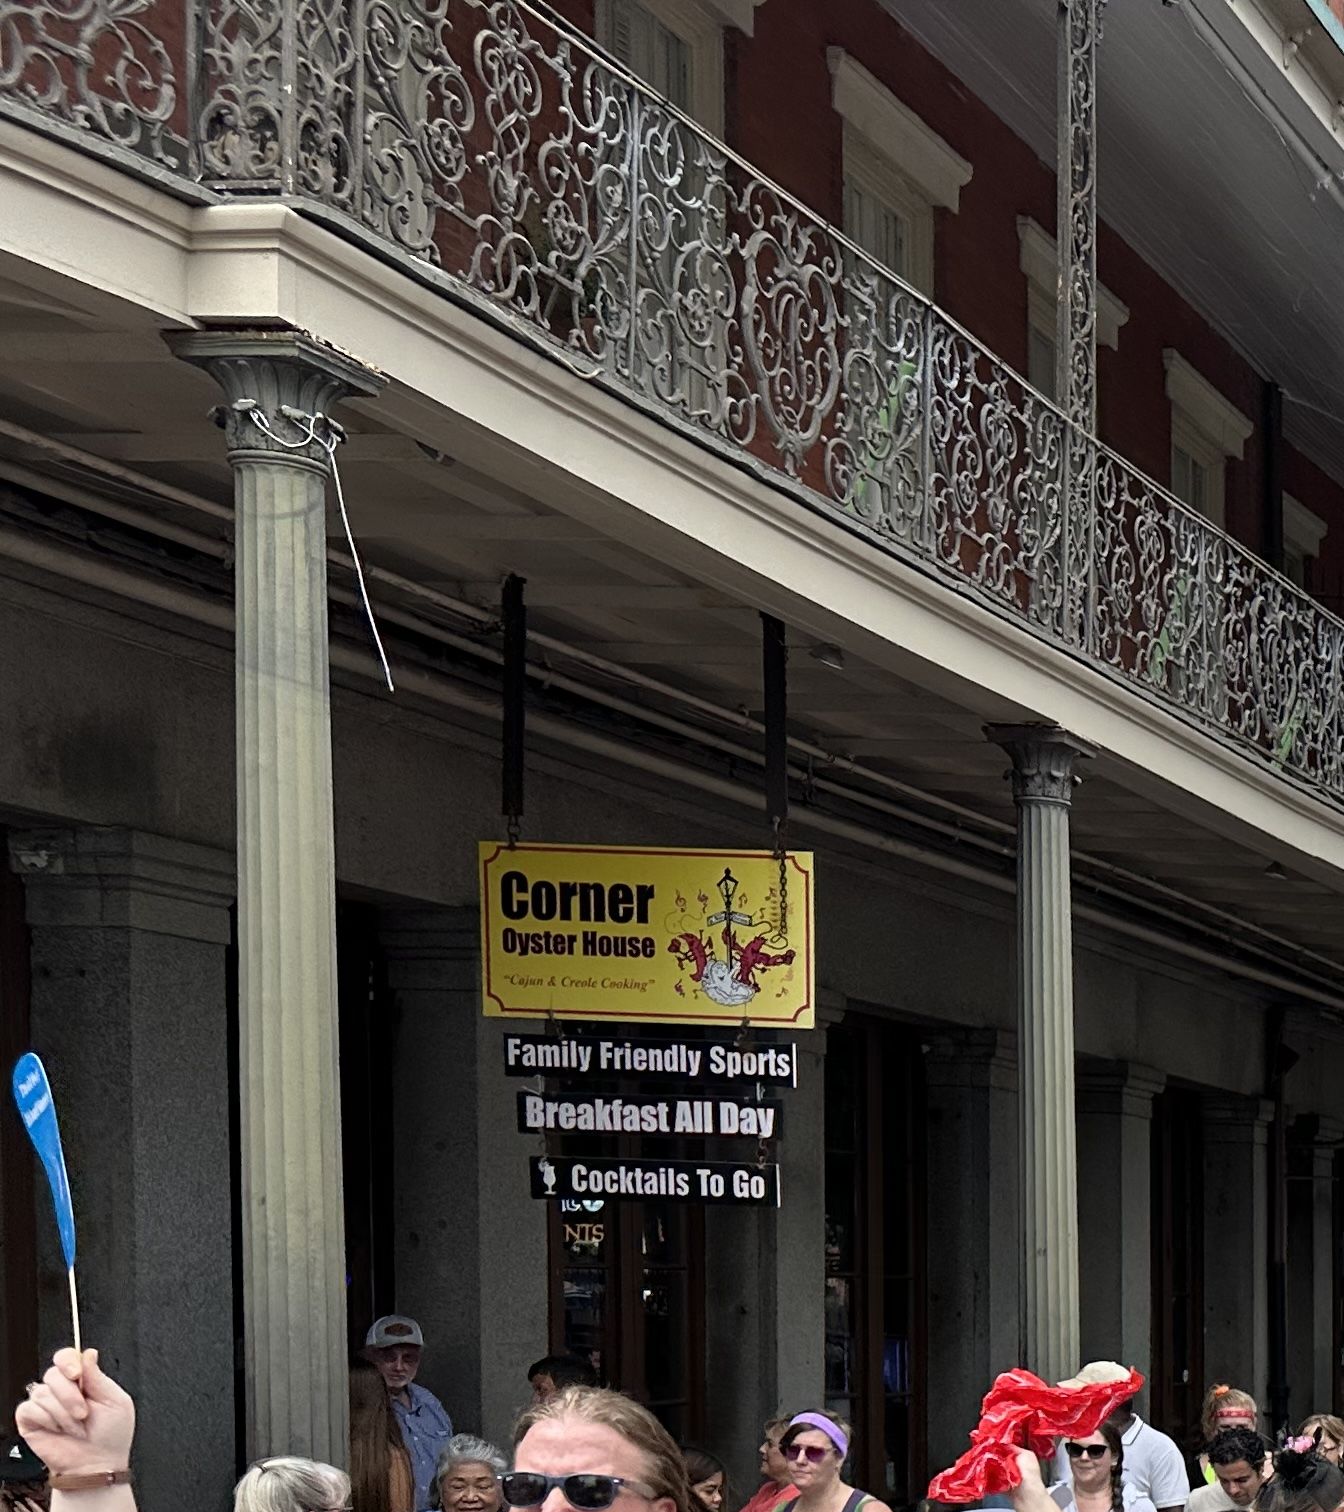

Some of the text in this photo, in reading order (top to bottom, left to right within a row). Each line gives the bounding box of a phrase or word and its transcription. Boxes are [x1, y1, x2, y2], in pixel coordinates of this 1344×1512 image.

[501, 871, 655, 924] Corner
[502, 928, 655, 958] Oyster House
[547, 975, 556, 987] &
[561, 976, 597, 989] Creole
[507, 1038, 791, 1079] Family Friendly Sports
[525, 1095, 775, 1138] Breakfast All Day
[571, 1164, 765, 1199] Cocktails To Go
